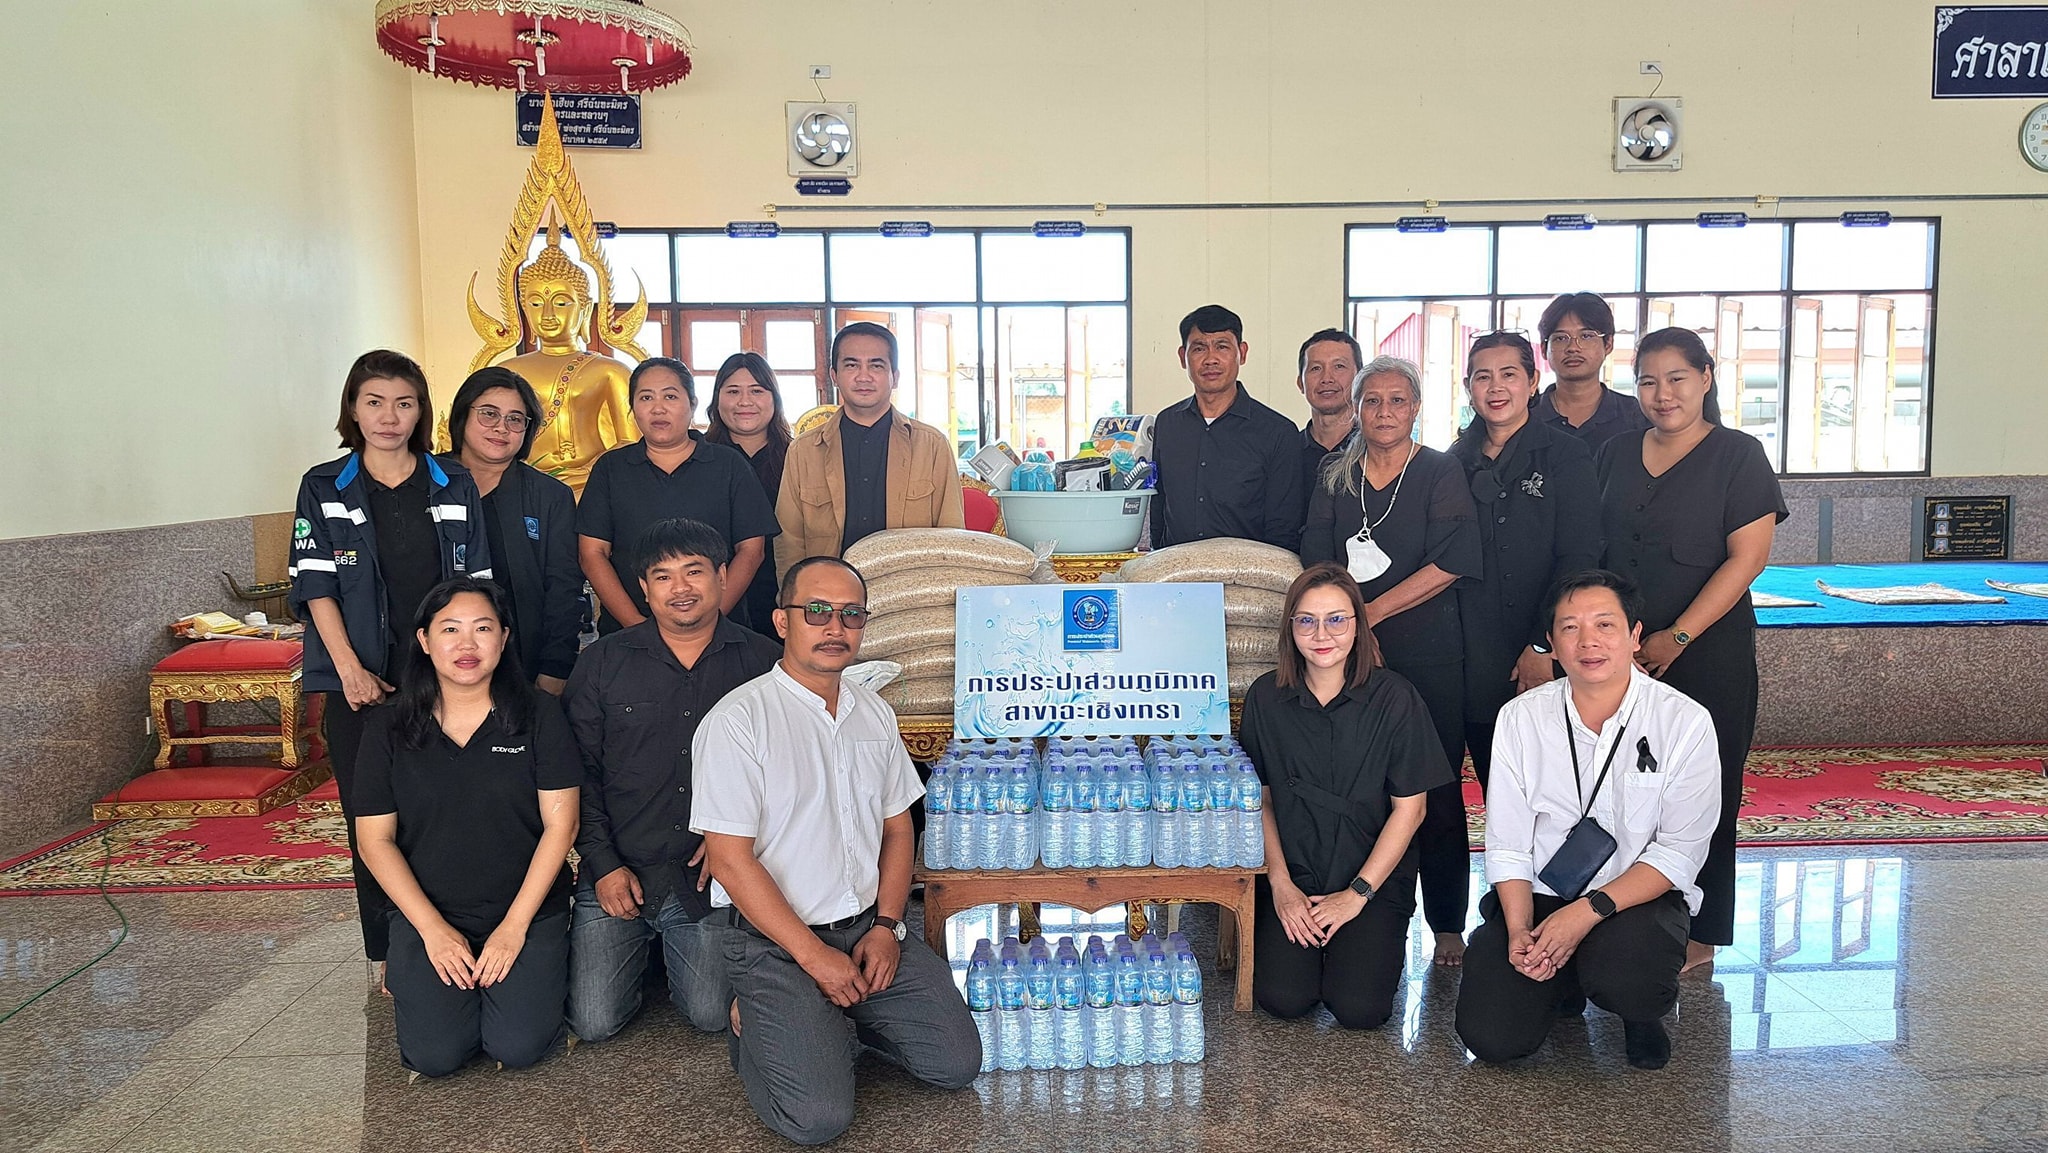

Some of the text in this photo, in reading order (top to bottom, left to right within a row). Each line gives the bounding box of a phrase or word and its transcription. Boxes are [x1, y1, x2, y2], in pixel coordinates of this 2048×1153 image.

[968, 671, 1216, 692] การประปาส่วนภูมิภาค
[1005, 702, 1181, 721] สาขาฉะเชิงเทรา
